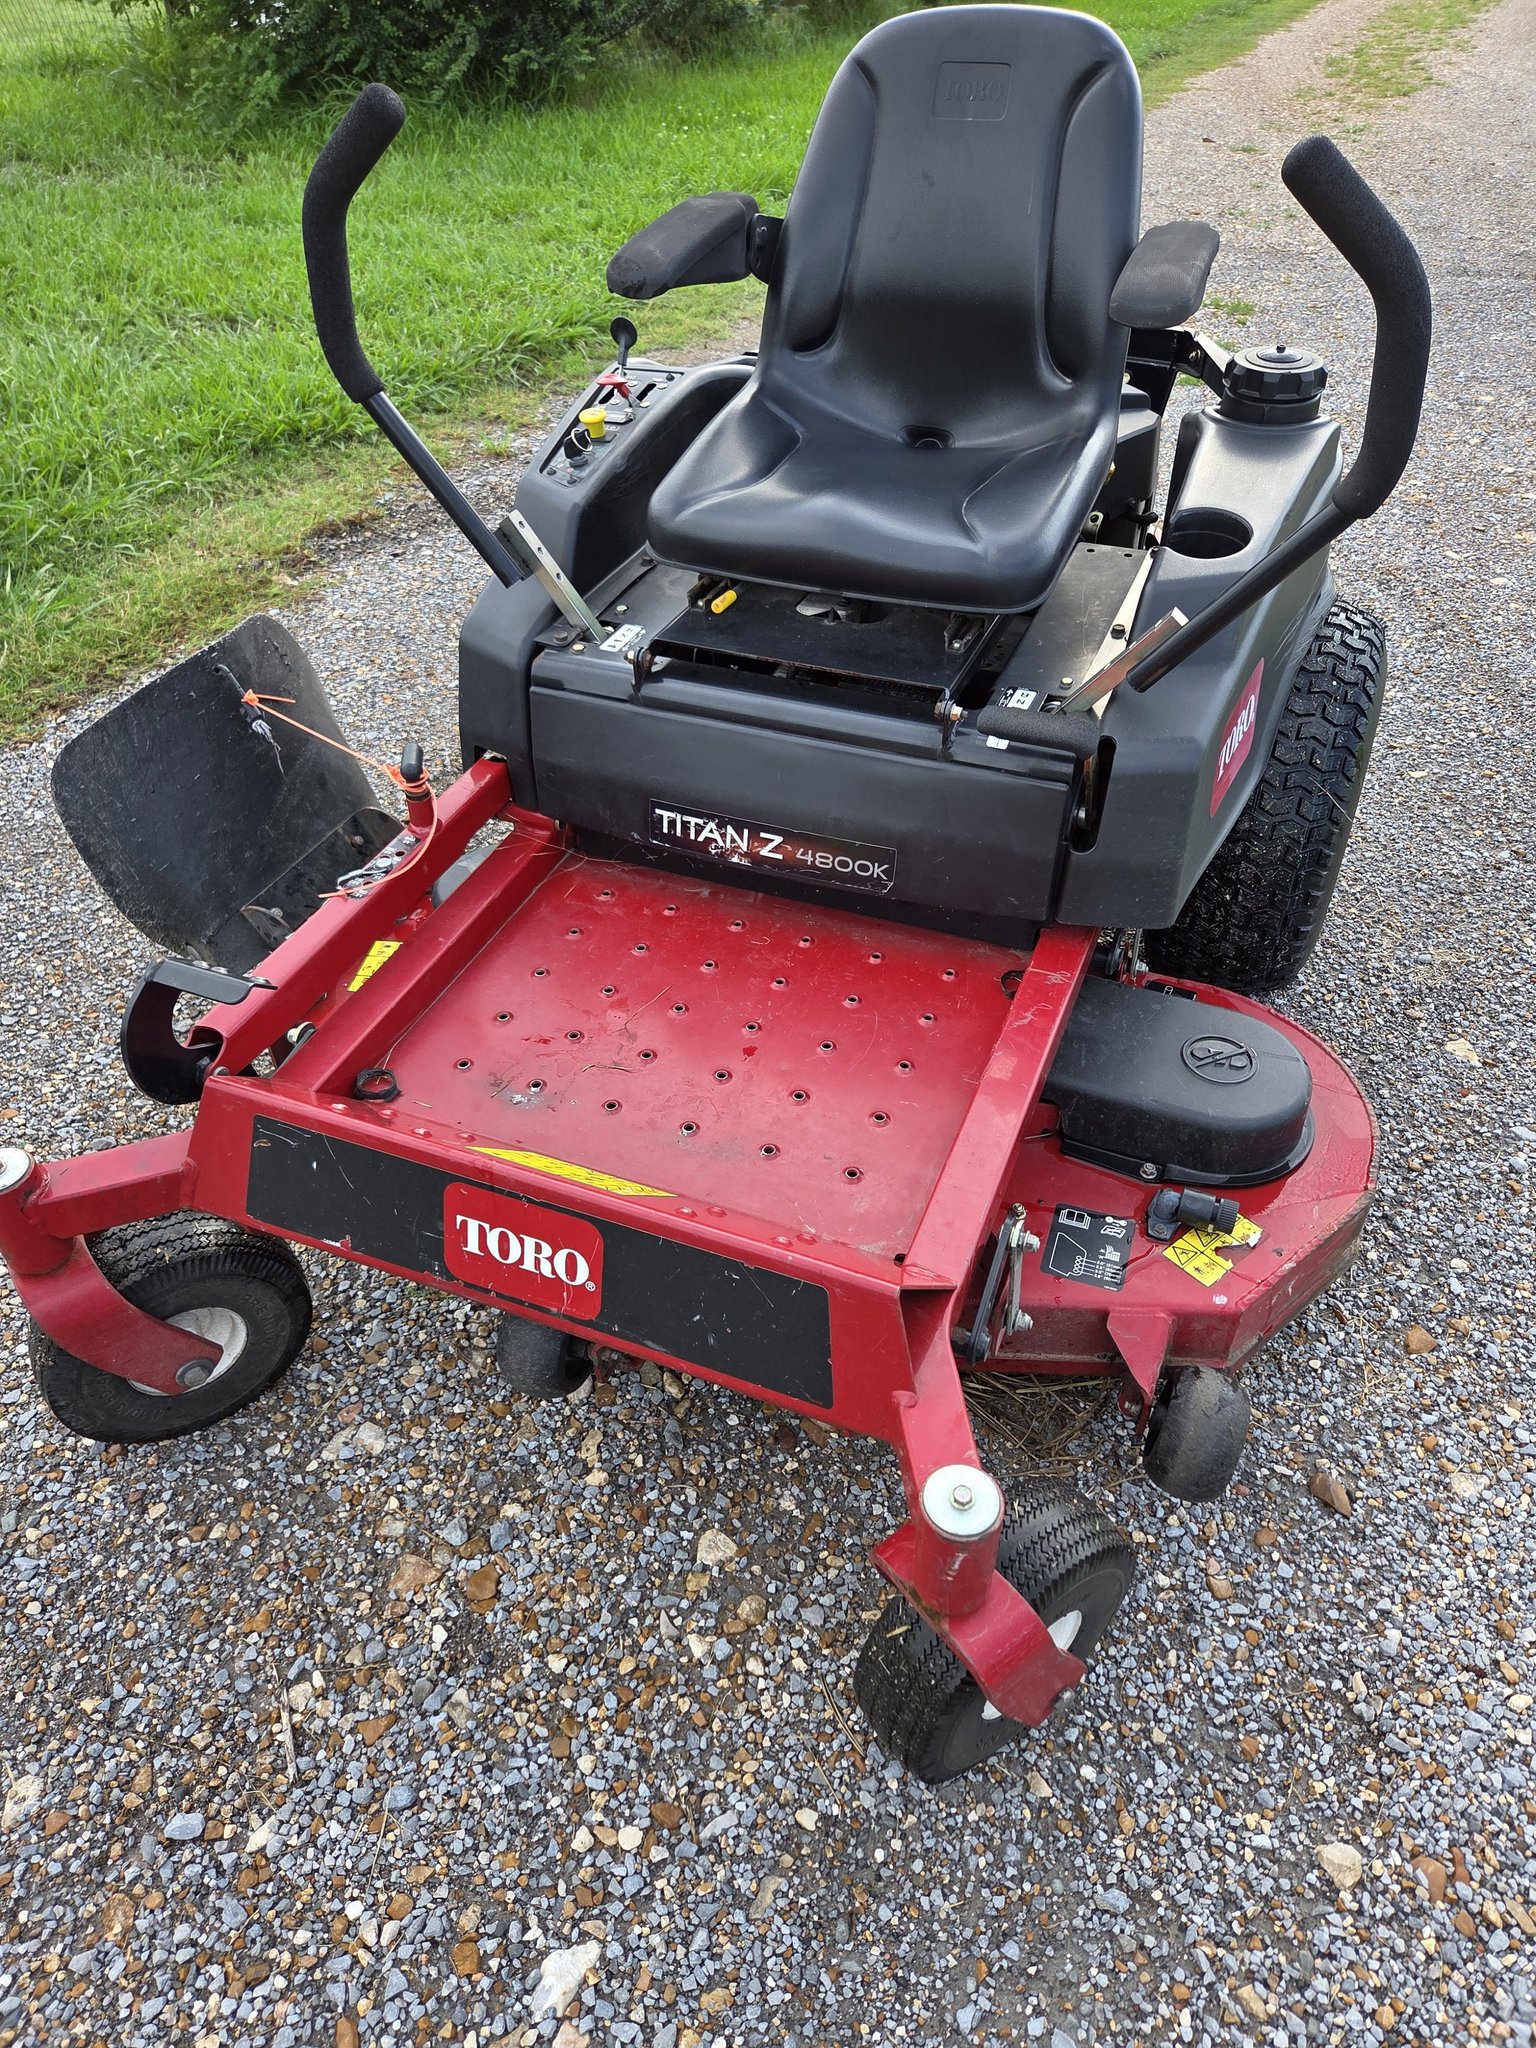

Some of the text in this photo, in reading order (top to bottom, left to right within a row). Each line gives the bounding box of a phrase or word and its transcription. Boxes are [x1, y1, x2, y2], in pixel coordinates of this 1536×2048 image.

[942, 80, 1001, 102] TORO
[1217, 694, 1256, 782] TORO
[654, 808, 890, 880] TITAN Z 4800K
